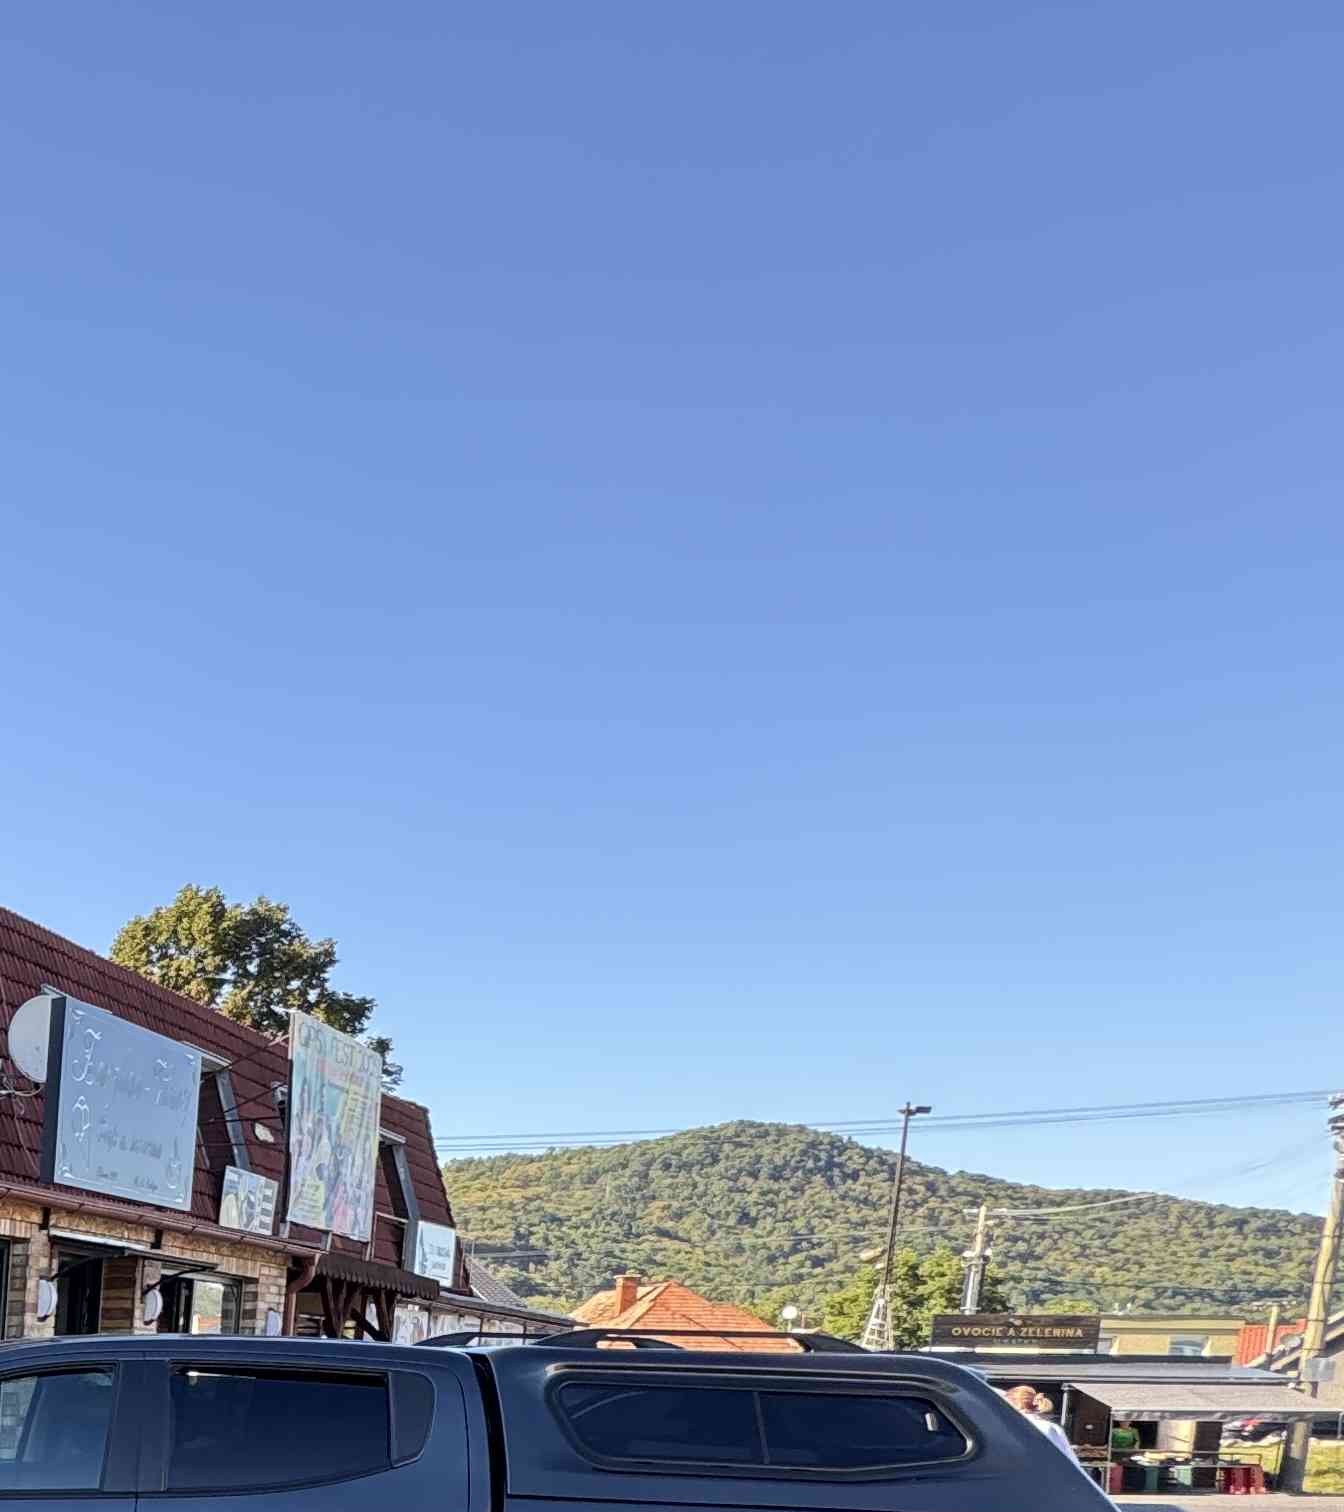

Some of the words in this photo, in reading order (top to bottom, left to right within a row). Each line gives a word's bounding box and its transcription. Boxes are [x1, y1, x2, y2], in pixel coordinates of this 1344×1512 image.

[951, 1326, 1004, 1337] OVOCIE
[1007, 1328, 1016, 1337] A
[1018, 1328, 1084, 1338] ZELENINA
